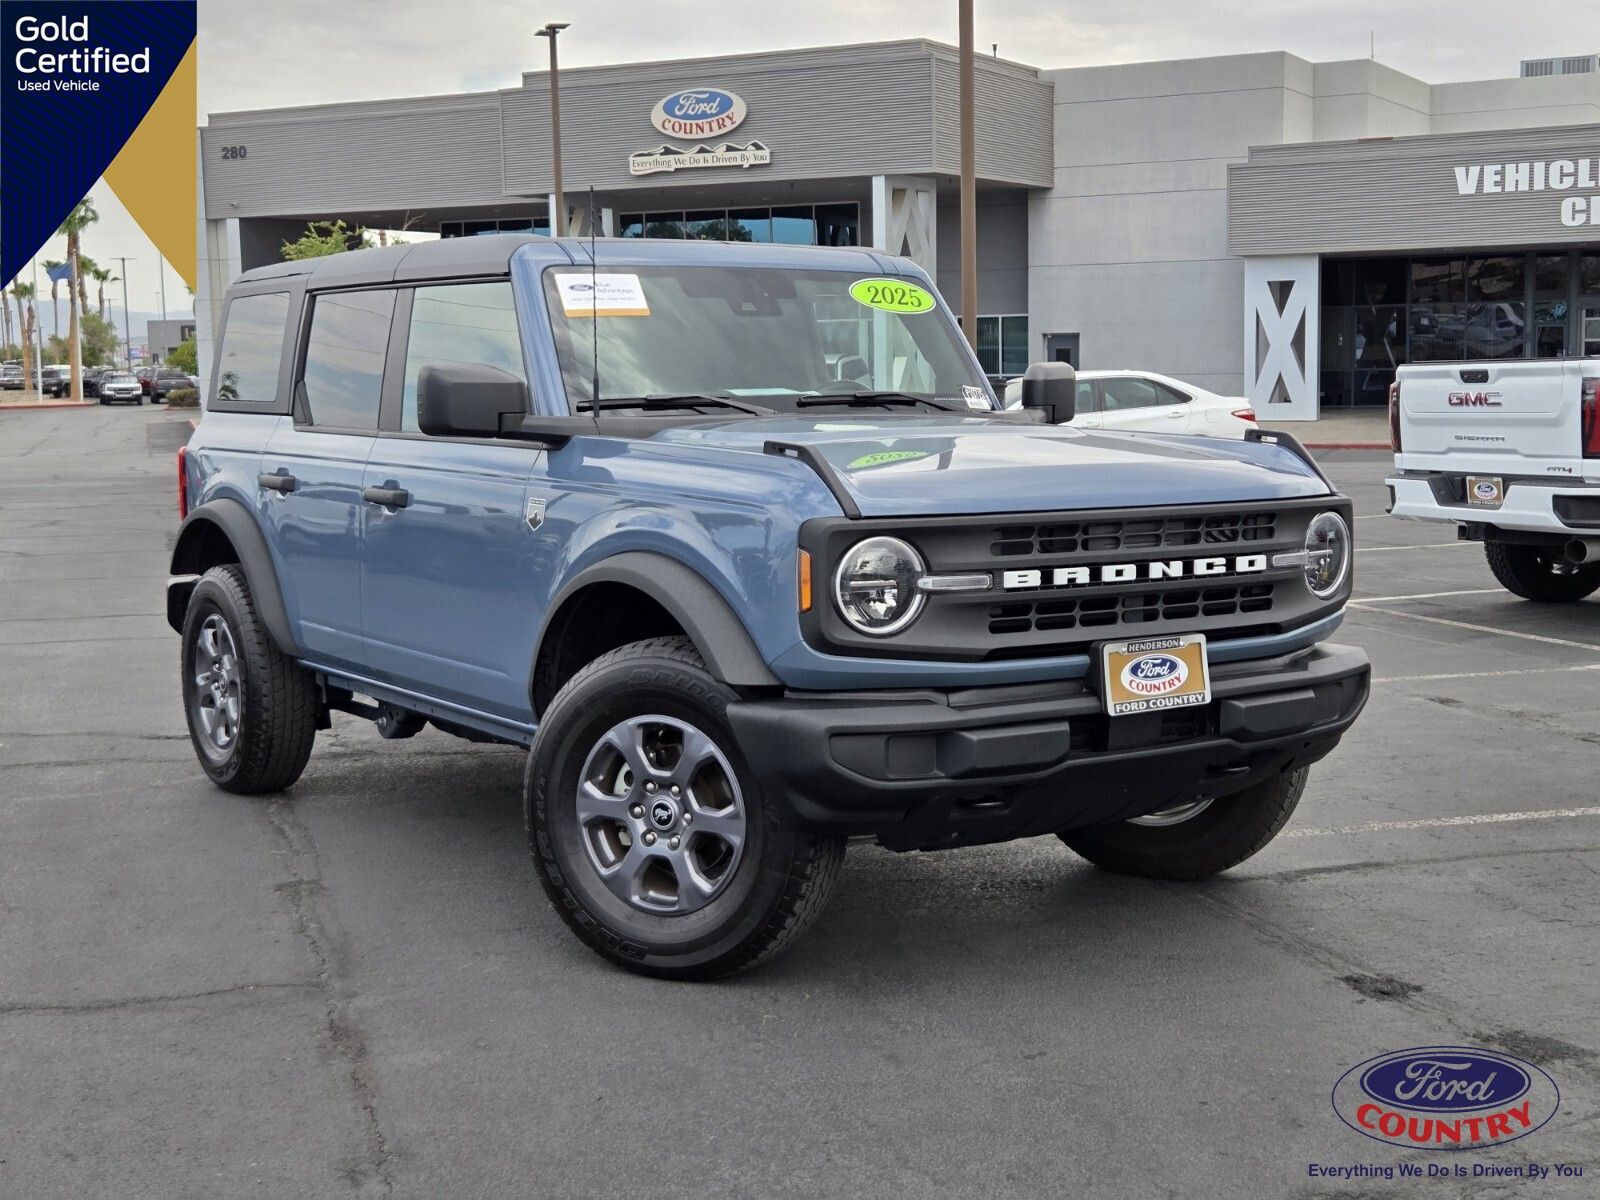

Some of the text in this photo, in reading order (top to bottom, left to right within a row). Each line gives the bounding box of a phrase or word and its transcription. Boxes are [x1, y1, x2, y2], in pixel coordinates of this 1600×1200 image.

[674, 93, 720, 116] Ford
[661, 112, 737, 135] COUNTRY
[221, 145, 247, 159] 280
[632, 153, 768, 169] Everything We Do Is Driven By You
[1454, 158, 1600, 194] VEHICL
[867, 285, 922, 308] 2025
[1448, 391, 1503, 407] GMC
[1454, 434, 1505, 442] SIERRA
[1003, 554, 1267, 589] BRONCO
[1128, 639, 1180, 652] HENDERSON
[1137, 658, 1171, 677] Ford
[1128, 673, 1182, 693] COUNTRY
[1115, 693, 1204, 713] FORD COUNTRY
